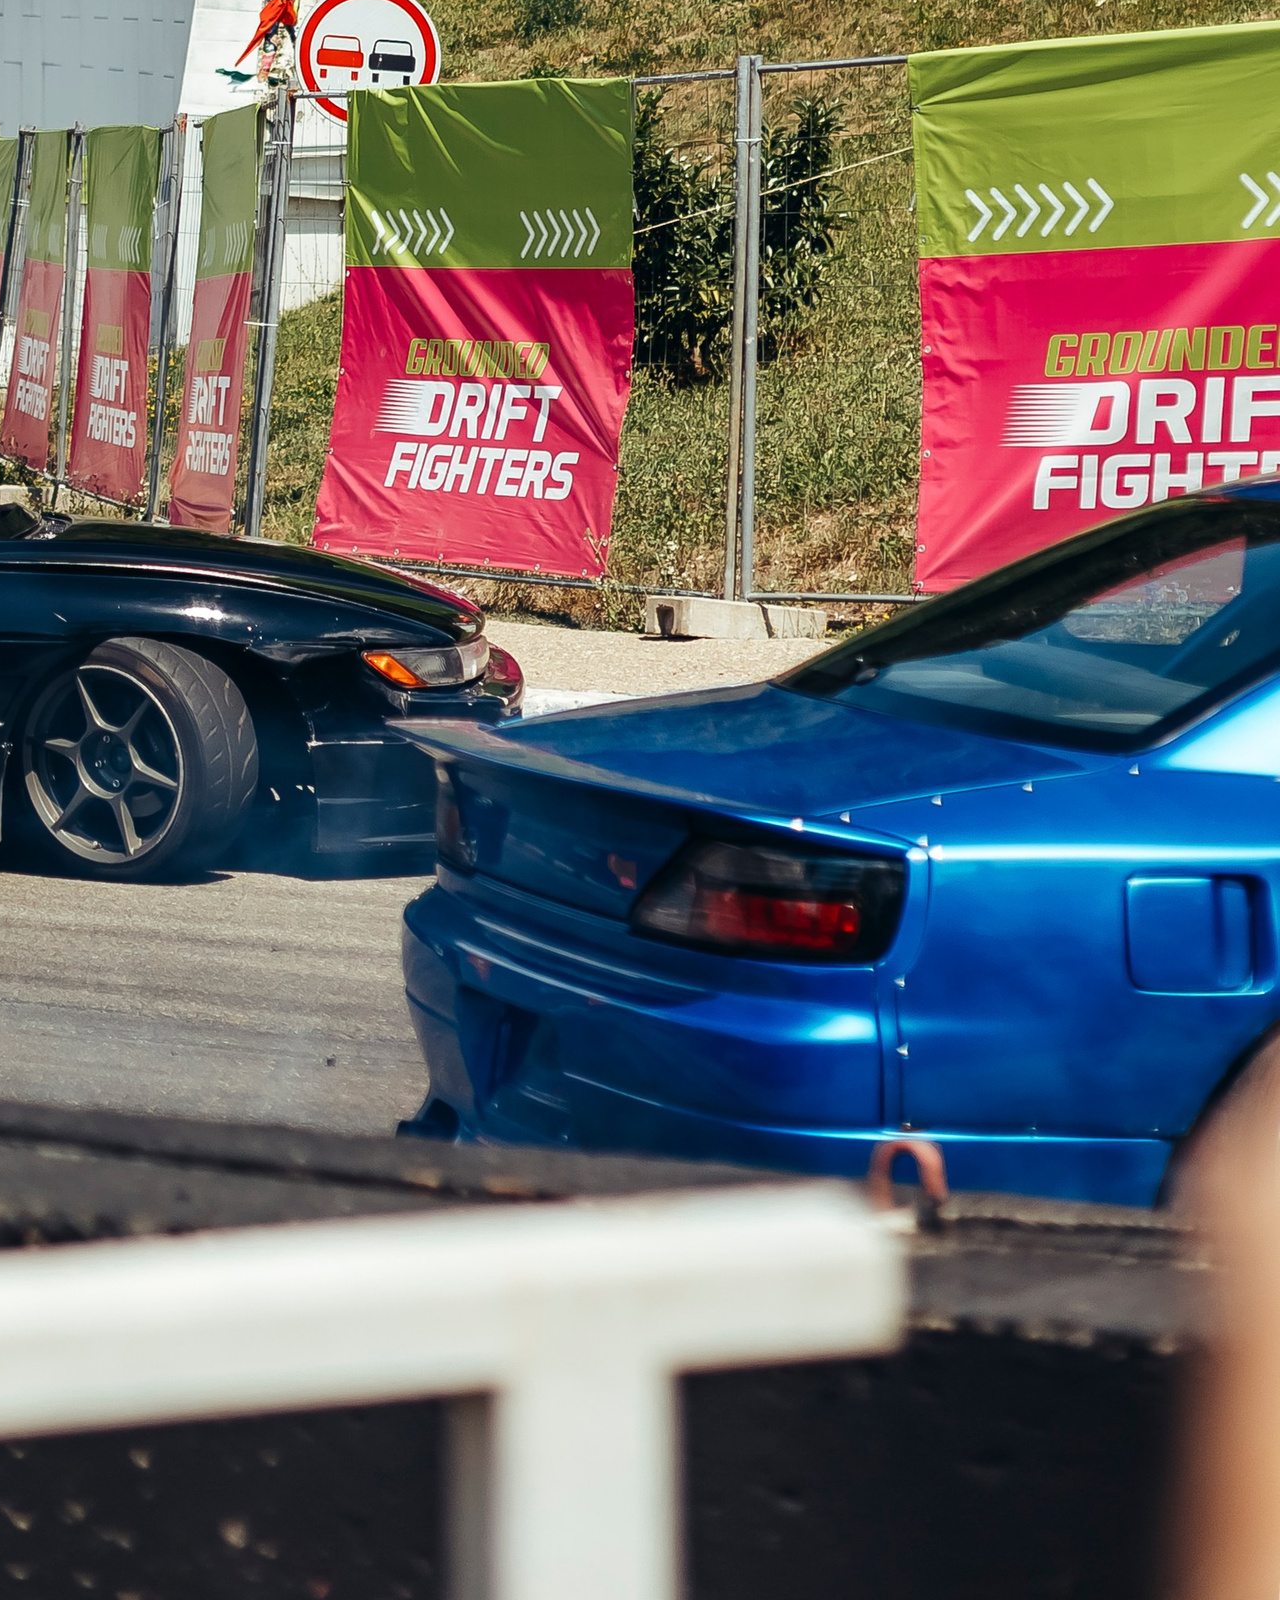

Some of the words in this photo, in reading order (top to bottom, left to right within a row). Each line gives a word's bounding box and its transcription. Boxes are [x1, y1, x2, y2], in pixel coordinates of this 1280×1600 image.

[89, 354, 129, 404] DRIFT
[405, 337, 551, 380] GROUNDED
[1044, 324, 1280, 378] GROUNDE
[86, 402, 137, 448] FIGHTERS
[373, 378, 564, 443] DRIFT
[998, 374, 1280, 447] DRIF
[383, 441, 581, 501] FIGHTERS
[1032, 451, 1280, 510] FIGHT
